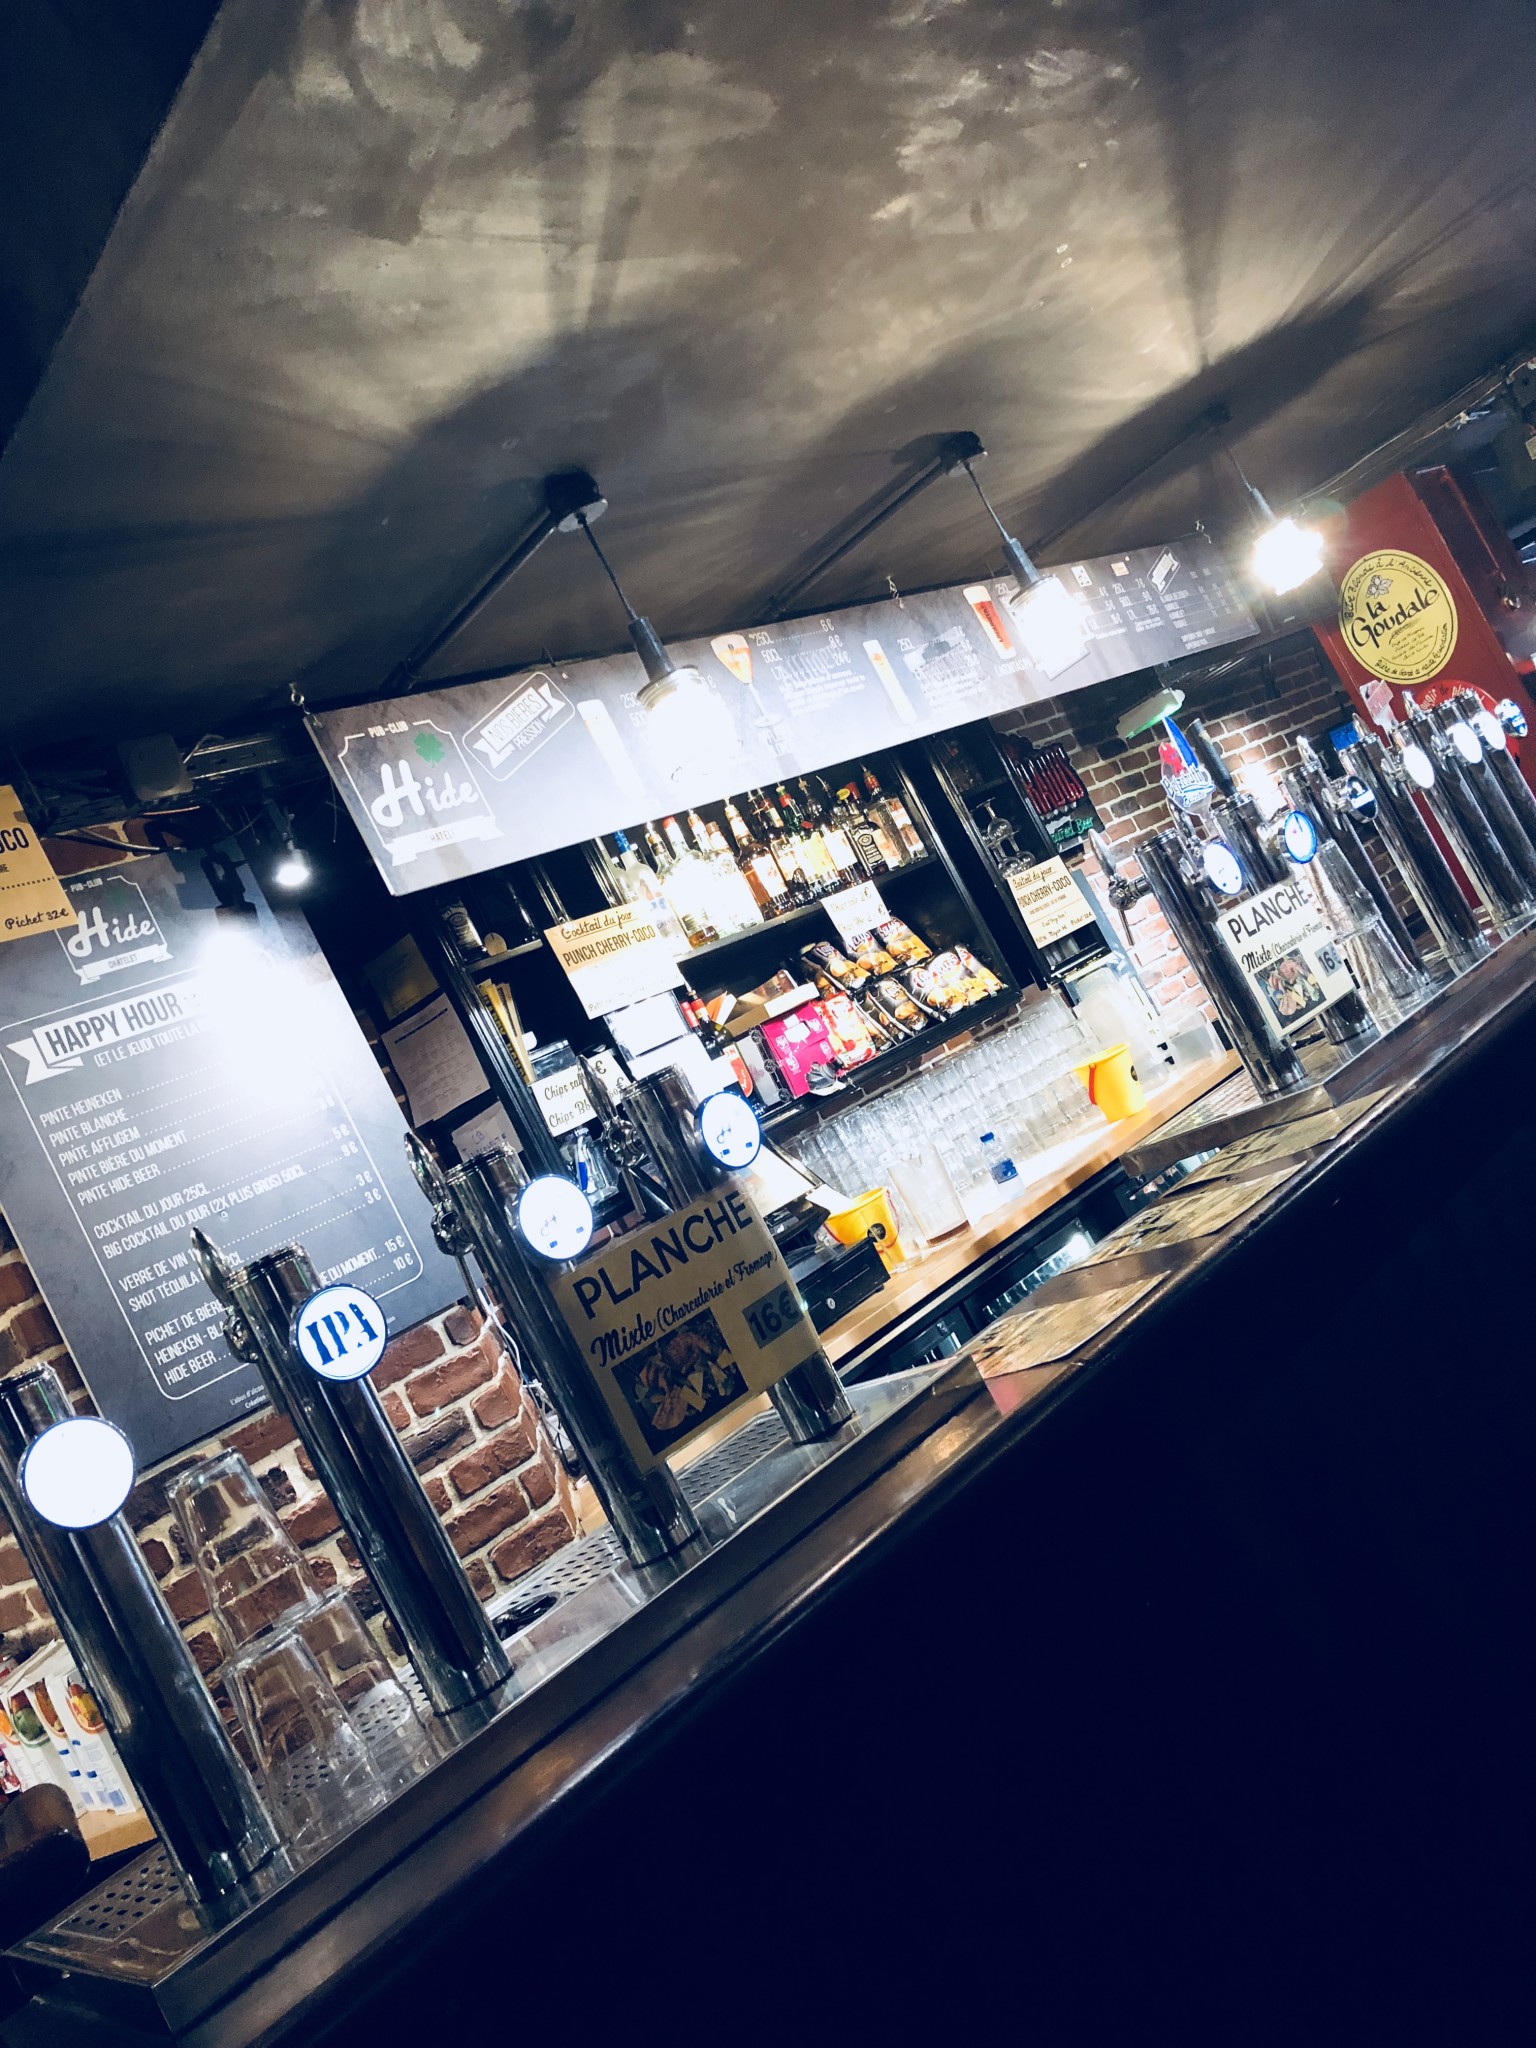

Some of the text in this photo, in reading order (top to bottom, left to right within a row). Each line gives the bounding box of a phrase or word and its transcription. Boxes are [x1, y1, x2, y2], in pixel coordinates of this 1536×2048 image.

[1351, 587, 1440, 649] Goudale
[368, 721, 409, 738] PUB-CLUB
[370, 759, 479, 828] Hide
[4, 908, 69, 930] Pichet 32€
[67, 906, 156, 957] Hide
[561, 911, 632, 939] Cocktail du jour
[1227, 881, 1309, 944] PLANCHE
[562, 925, 656, 967] PUNCH CHERRY-COCO
[1241, 944, 1272, 973] Mixte
[45, 992, 183, 1057] HAPPY HOUR
[114, 1047, 128, 1062] LE
[126, 1035, 155, 1057] JEUDI
[152, 1025, 186, 1048] TOUTE
[39, 1088, 123, 1128] PINTE HEINEKEN
[544, 1080, 569, 1100] Chips
[49, 1107, 129, 1147] PINTE BLANCHE
[549, 1105, 575, 1128] Chips
[58, 1126, 141, 1167] PINTE AFFLIGEM
[67, 1164, 101, 1187] PINTE
[100, 1155, 131, 1175] BIÈRE
[127, 1144, 146, 1163] DU
[143, 1129, 188, 1156] MOMENT
[77, 1163, 162, 1206] PINTE HIDE BEER
[93, 1212, 144, 1239] COCKTAIL
[142, 1203, 158, 1218] DU
[160, 1193, 184, 1213] JOUR
[183, 1182, 210, 1202] 25CL
[102, 1242, 122, 1260] BIG
[121, 1224, 171, 1252] COCKTAIL
[168, 1215, 185, 1232] DU
[186, 1204, 211, 1225] JOUR
[210, 1195, 229, 1214] (2X
[227, 1185, 253, 1208] PLUS
[252, 1173, 281, 1196] GROS)
[280, 1164, 306, 1184] 50CL
[118, 1270, 156, 1292] VERRE
[155, 1260, 171, 1277] DE
[168, 1251, 187, 1272] VIN
[573, 1190, 753, 1320] PLANCHE
[128, 1293, 157, 1313] SHOT
[155, 1273, 199, 1299] TÉQUILA
[153, 1333, 204, 1366] HEINEKEN
[327, 1263, 345, 1282] DU
[341, 1248, 379, 1275] MOMENT
[589, 1248, 778, 1368] Mixte (Charcuterie et Fromage)
[144, 1320, 182, 1346] PICHET
[183, 1313, 197, 1328] DE
[305, 1303, 378, 1366] IPA
[750, 1288, 800, 1342] 16€
[163, 1365, 190, 1386] HIDE
[190, 1350, 217, 1373] BEER
